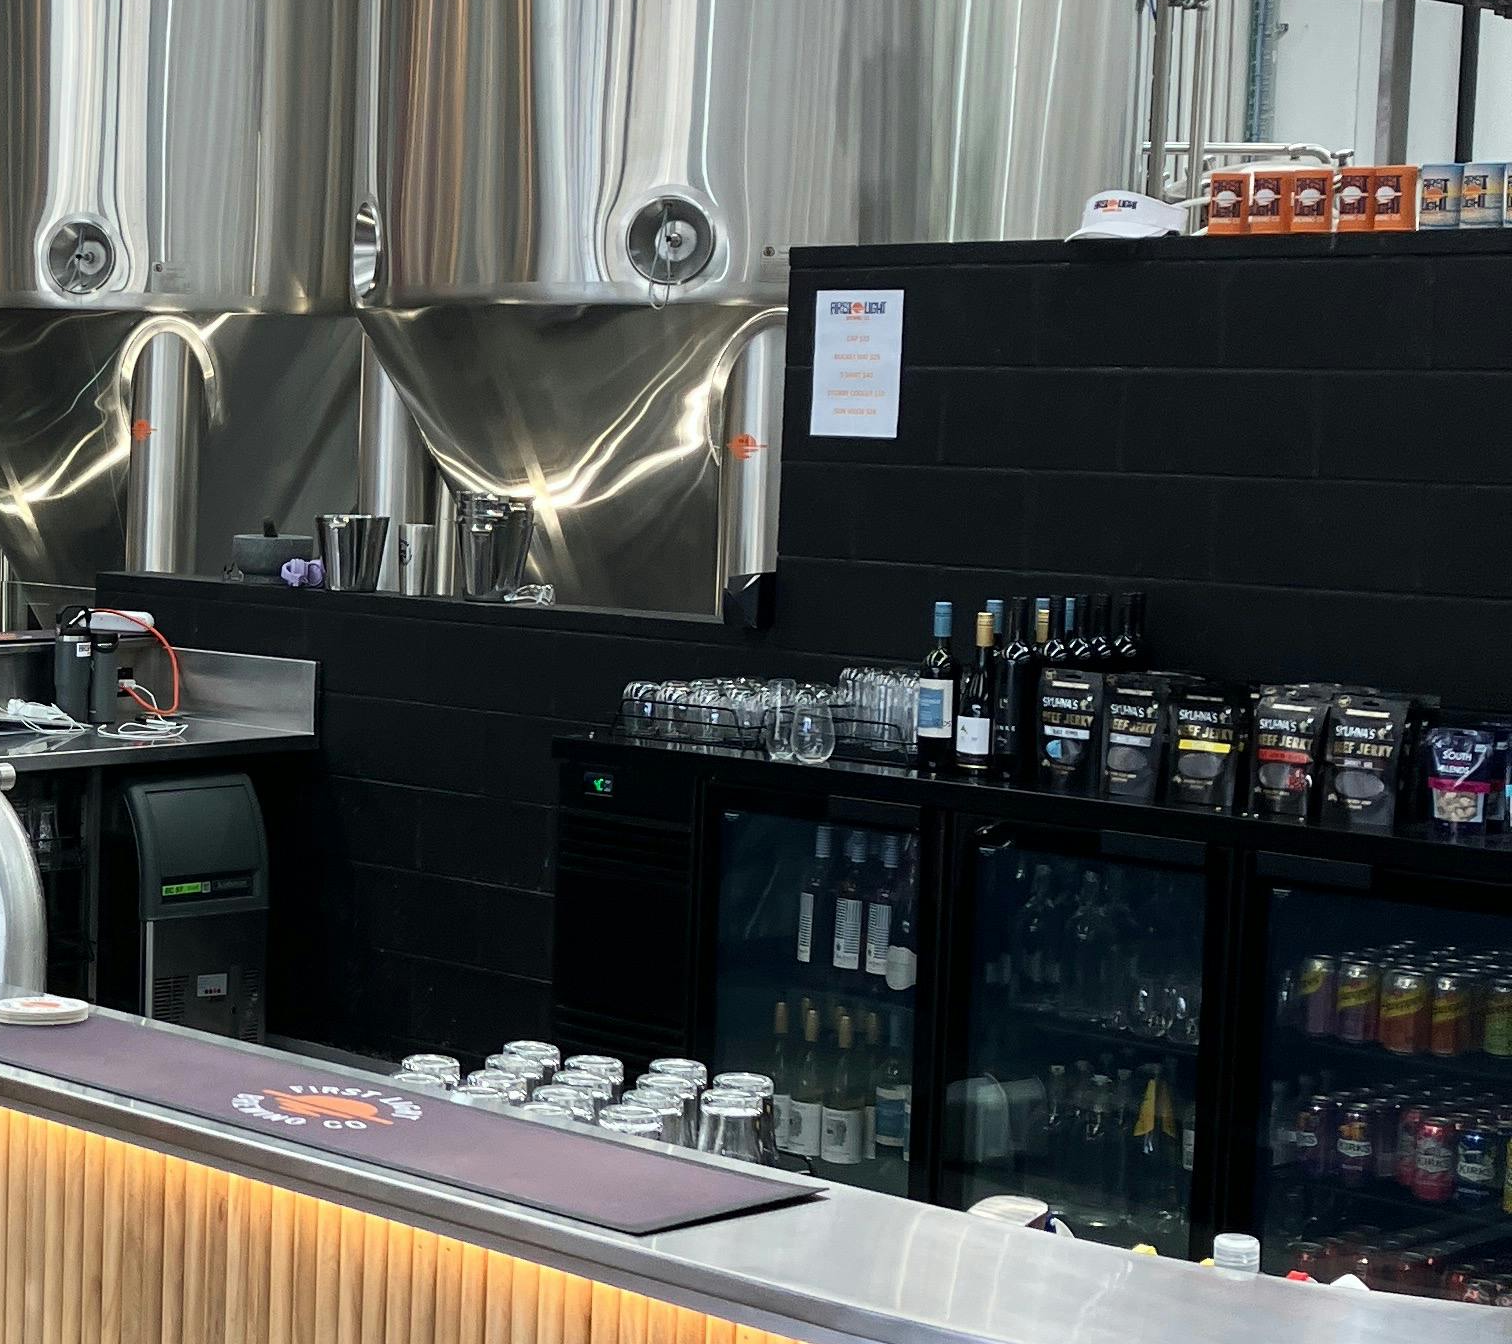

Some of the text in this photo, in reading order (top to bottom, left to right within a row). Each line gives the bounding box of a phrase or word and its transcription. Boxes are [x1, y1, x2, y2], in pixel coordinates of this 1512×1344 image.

[864, 301, 887, 315] LIGHT
[1064, 713, 1094, 728] JERKY
[1278, 735, 1313, 750] JERKY
[1356, 743, 1393, 757] JERKY
[288, 1085, 382, 1099] FIRST
[322, 1120, 367, 1129] CO
